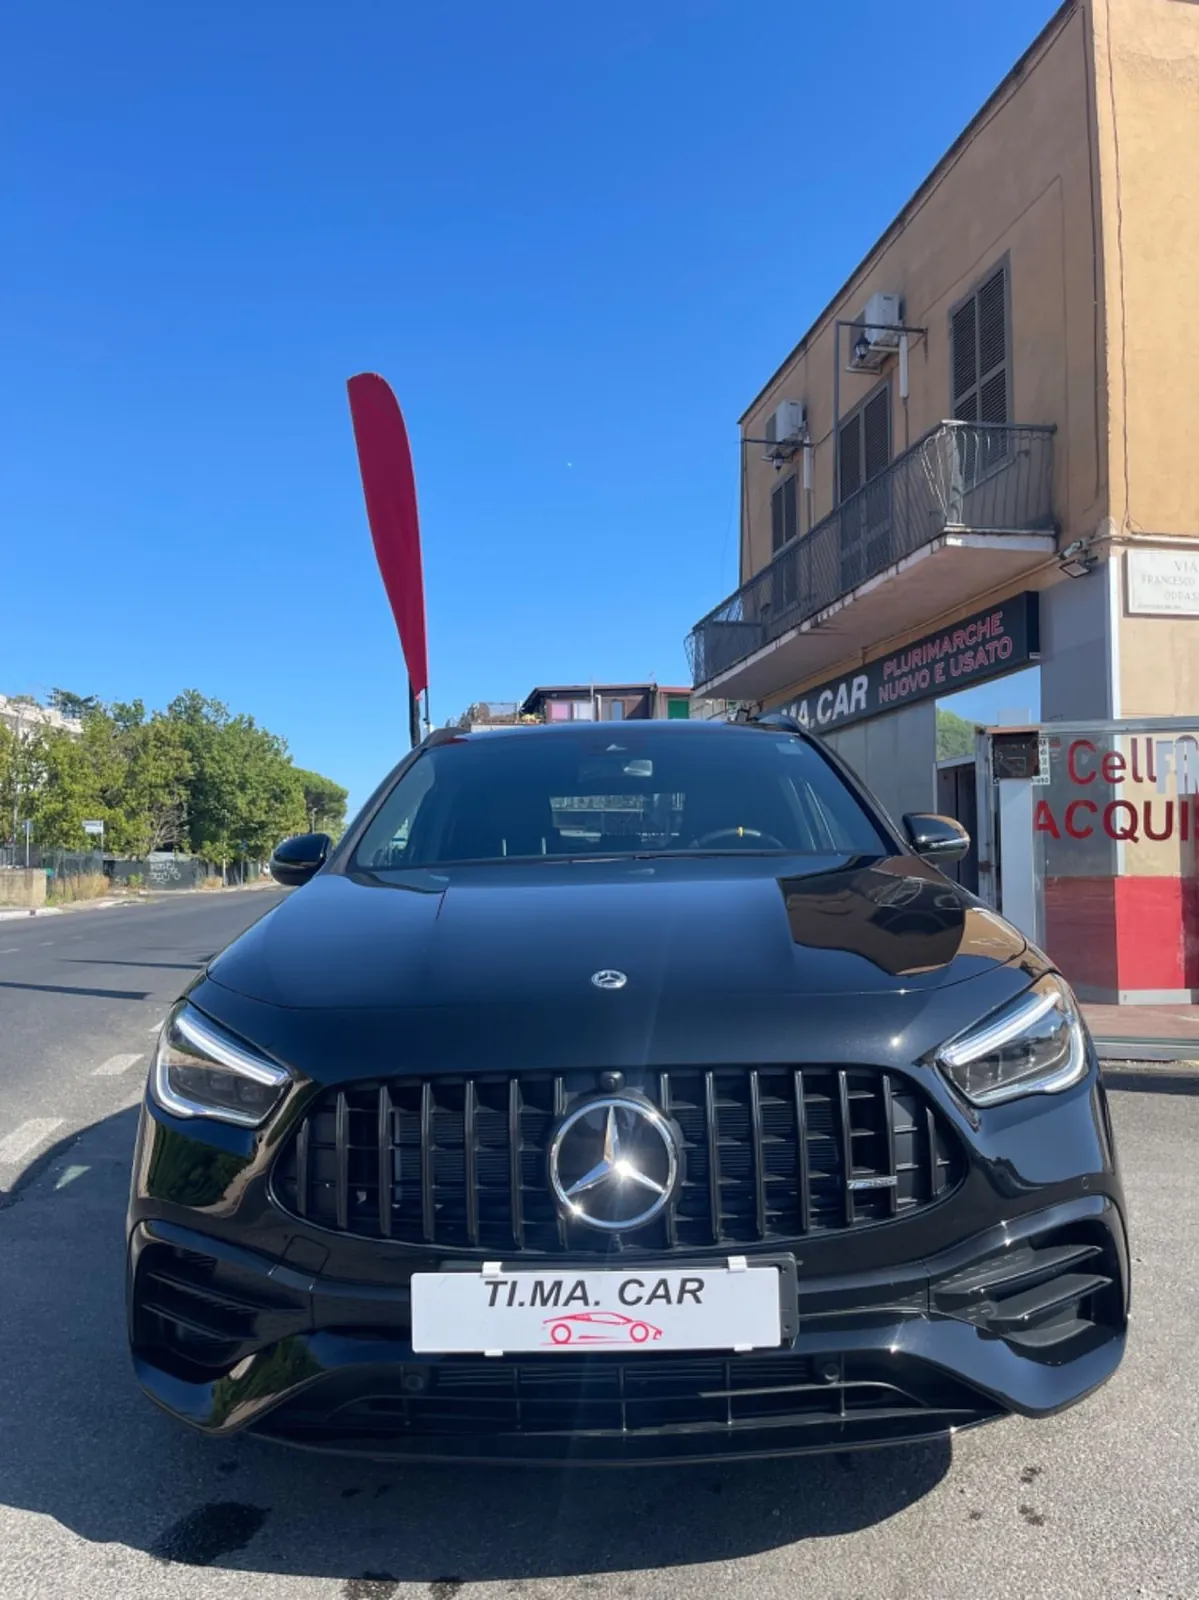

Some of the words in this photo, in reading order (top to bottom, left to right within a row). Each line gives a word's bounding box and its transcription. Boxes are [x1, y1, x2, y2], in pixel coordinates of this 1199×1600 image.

[1173, 560, 1198, 573] VIA
[883, 611, 1005, 680] PLURIMARCHE
[878, 668, 930, 704] NUOVO
[934, 662, 946, 683] E
[950, 636, 1013, 677] USATO
[1034, 799, 1199, 843] ACQUI
[618, 1277, 706, 1306] CAR
